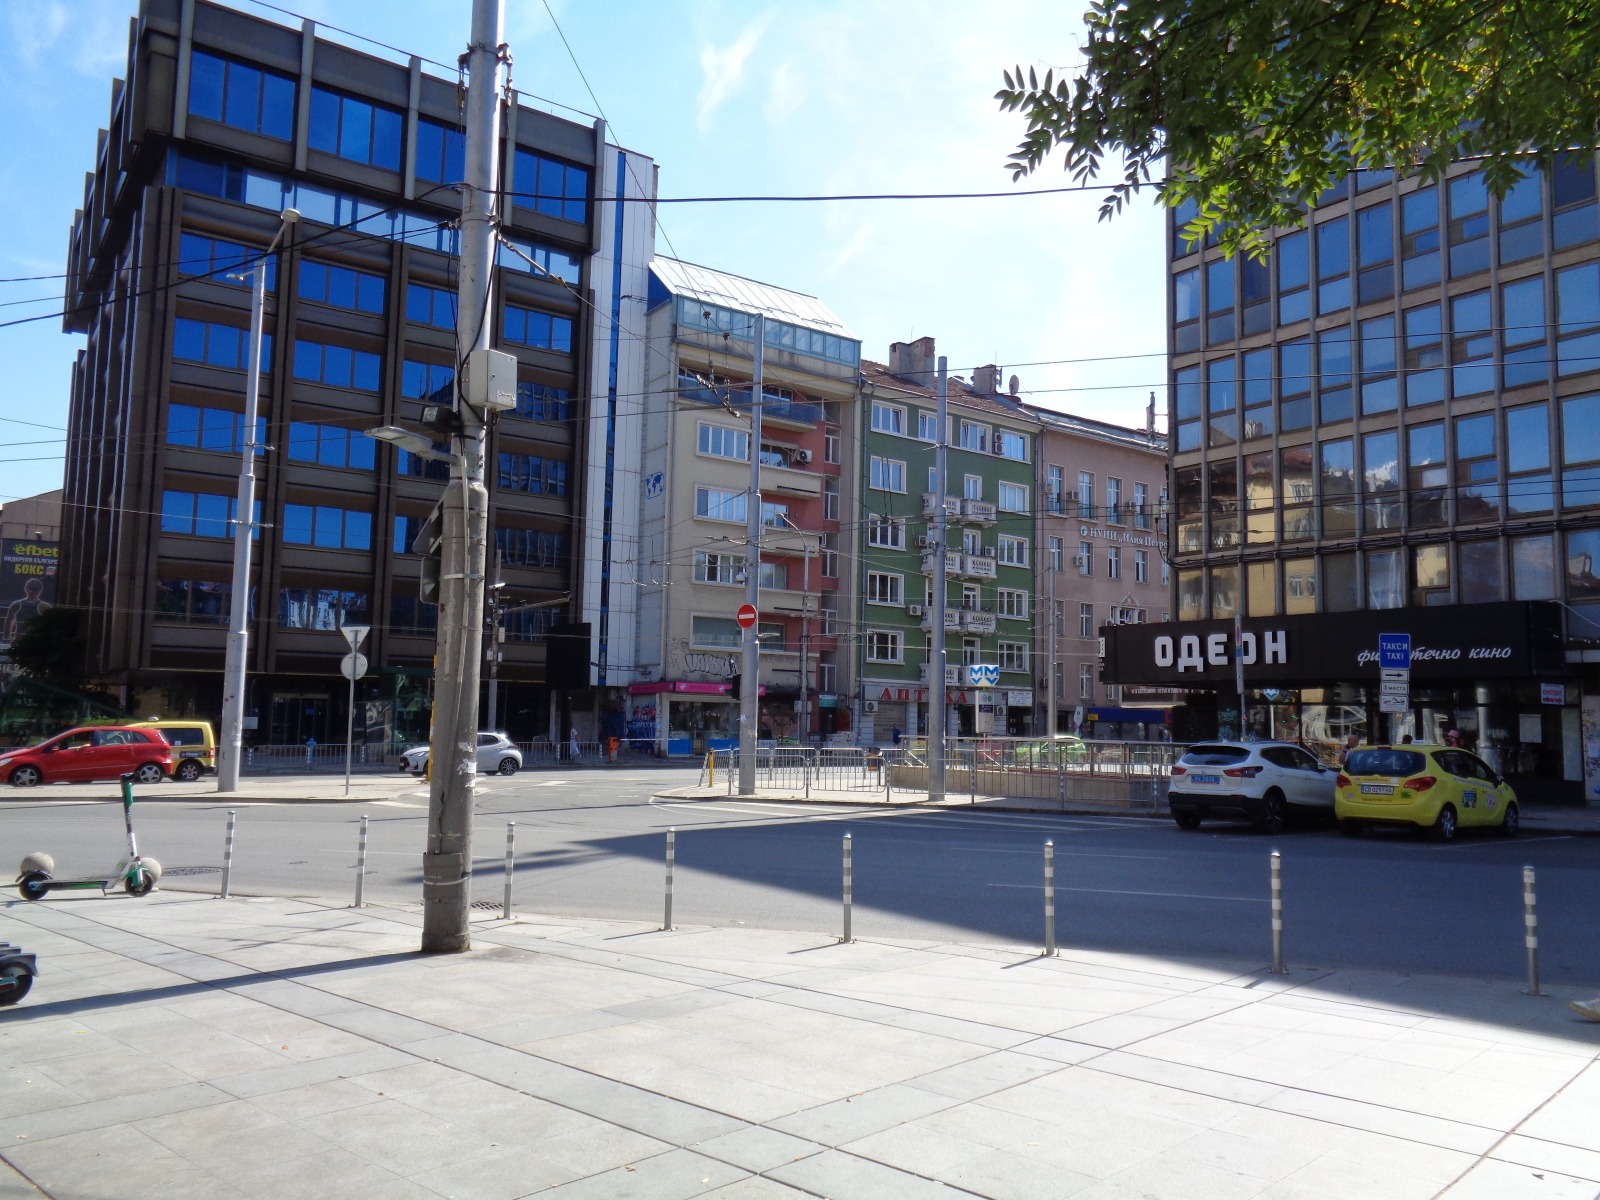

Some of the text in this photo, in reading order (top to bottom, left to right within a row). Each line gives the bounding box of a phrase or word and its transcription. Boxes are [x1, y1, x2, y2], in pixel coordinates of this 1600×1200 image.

[1090, 528, 1118, 541] НУИИ
[15, 545, 58, 557] efbet
[15, 564, 43, 575] БОКС
[1155, 631, 1287, 672] ОДЕОН
[1382, 642, 1408, 651] ТАКСИ
[1357, 646, 1512, 667] фитечно кино
[1386, 652, 1404, 660] TAXI
[879, 687, 968, 704] АПТКА
